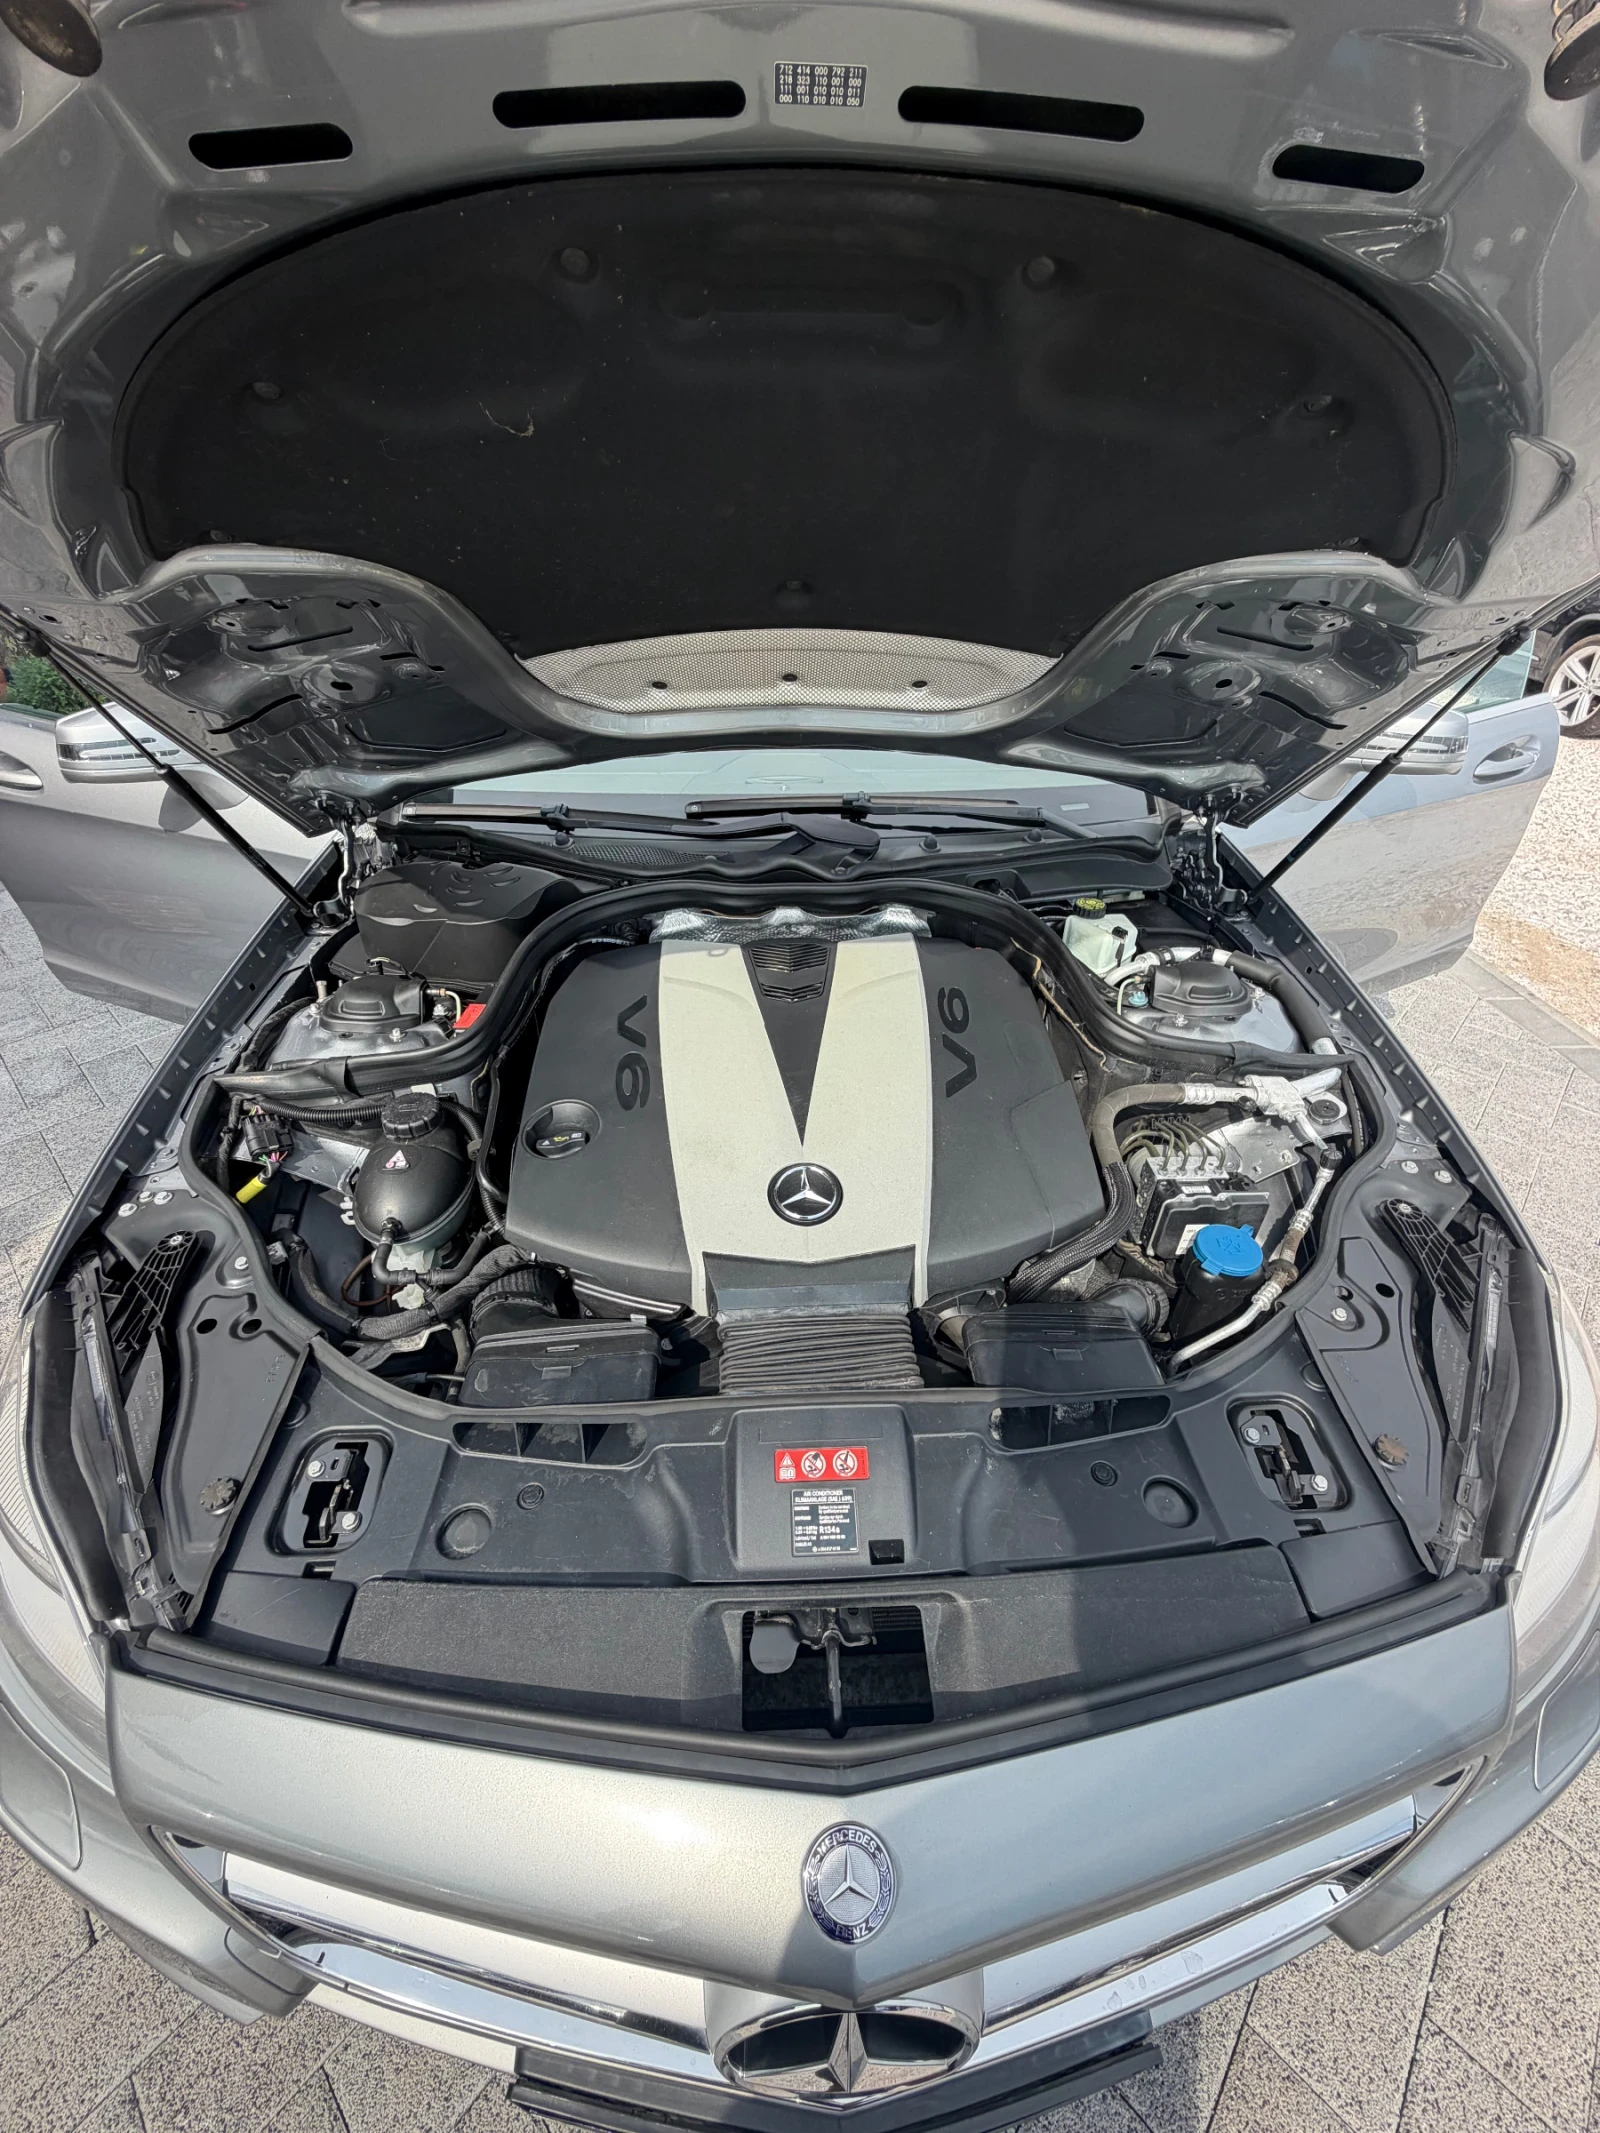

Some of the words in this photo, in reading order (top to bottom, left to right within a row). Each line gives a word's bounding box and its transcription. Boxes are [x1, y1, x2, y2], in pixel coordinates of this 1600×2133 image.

[780, 65, 793, 74] 712
[797, 66, 810, 74] 414
[814, 66, 828, 75] 000
[850, 68, 862, 77] 211
[815, 77, 827, 85] 110
[831, 77, 844, 86] 001
[849, 78, 861, 86] 000
[796, 86, 809, 94] 001
[814, 87, 827, 95] 010
[831, 87, 844, 96] 010
[848, 88, 860, 96] 011
[779, 94, 792, 102] 000
[813, 96, 826, 104] 010
[830, 97, 843, 105] 010
[937, 986, 978, 1099] V6
[614, 994, 650, 1111] V6
[816, 1829, 878, 1857] MERCEDES
[835, 1923, 869, 1939] BENZ
